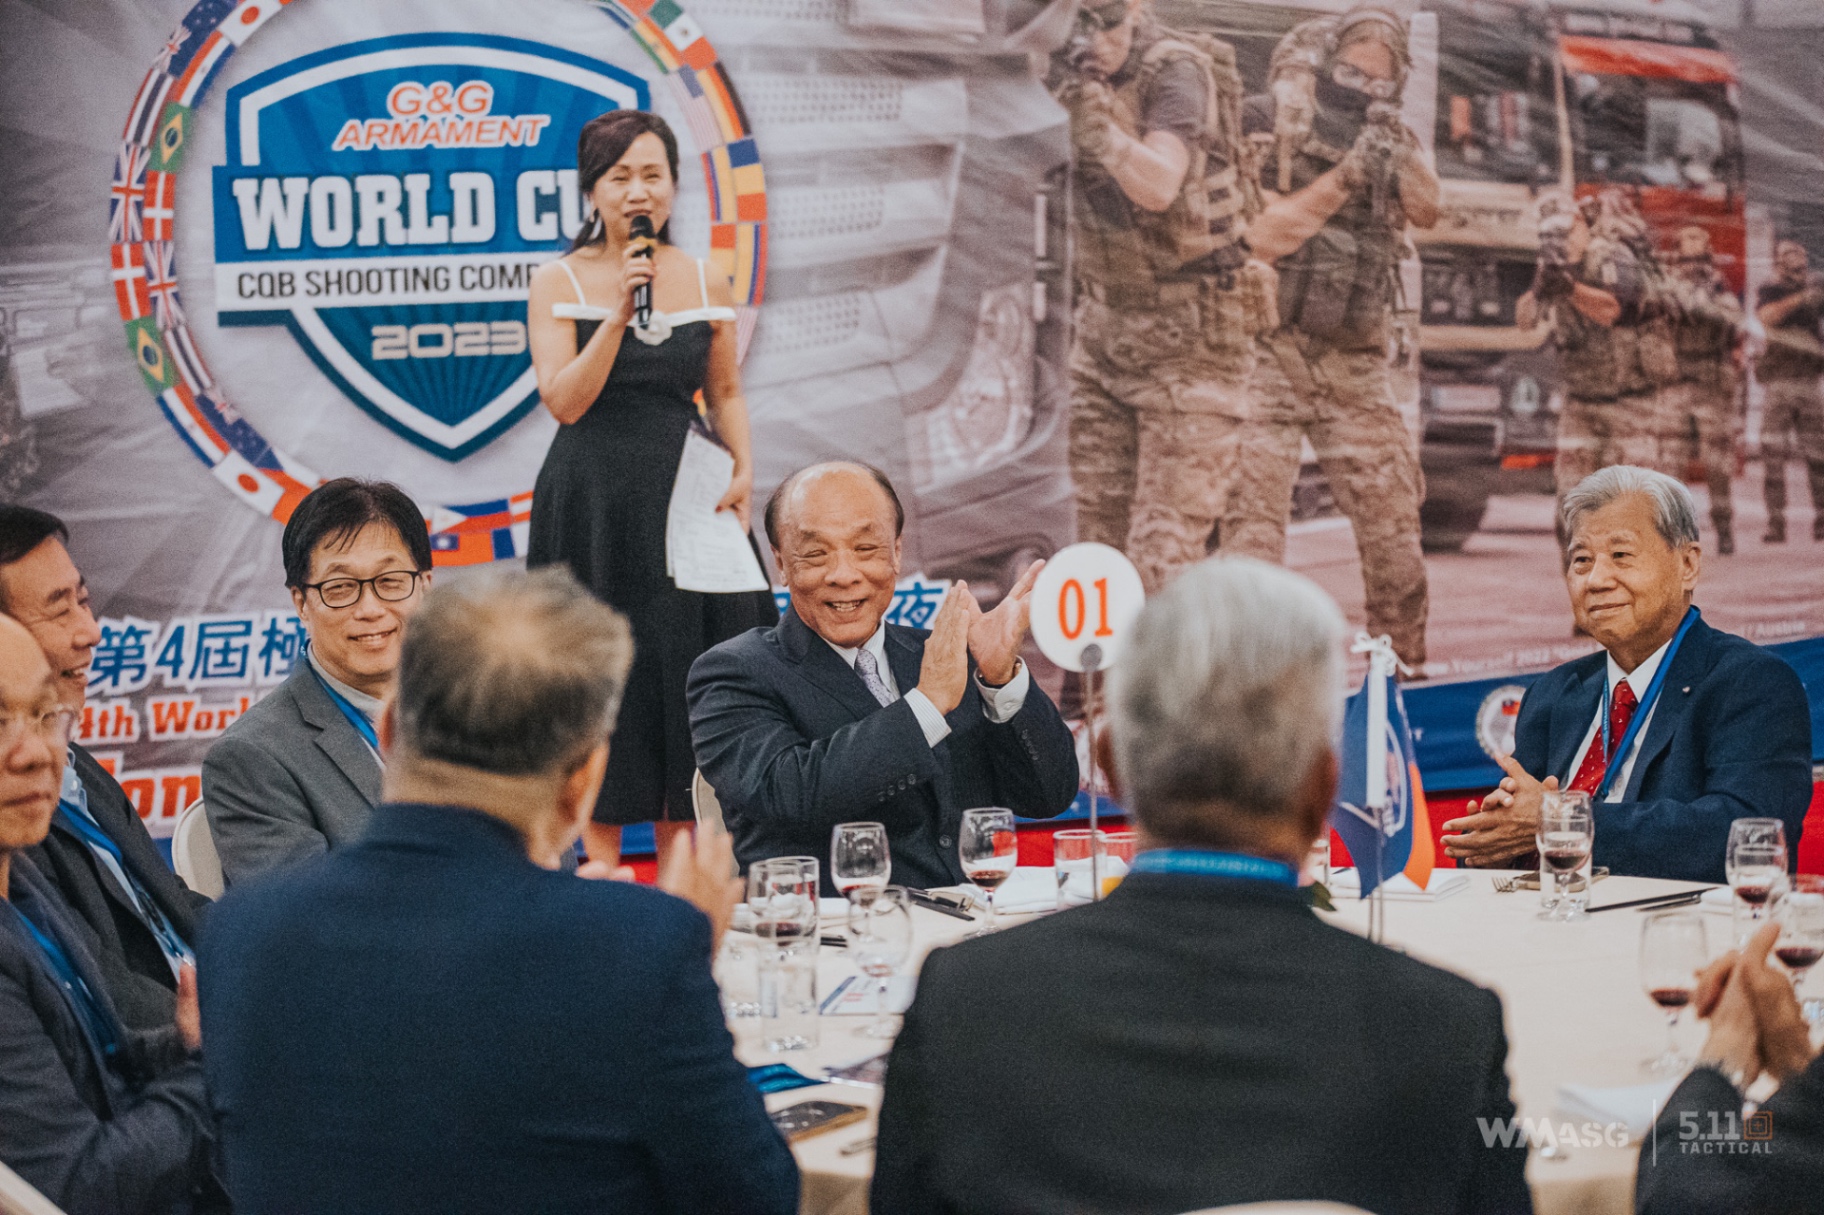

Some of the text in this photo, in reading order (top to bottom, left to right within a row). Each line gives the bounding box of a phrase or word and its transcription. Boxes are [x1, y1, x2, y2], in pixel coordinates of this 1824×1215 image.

[388, 81, 493, 117] G&G
[334, 116, 547, 149] ARMAMENT
[232, 172, 496, 250] WORLD
[237, 272, 296, 299] CQB
[305, 266, 449, 297] SHOOTING
[371, 320, 527, 360] 2023
[1058, 577, 1113, 640] 01
